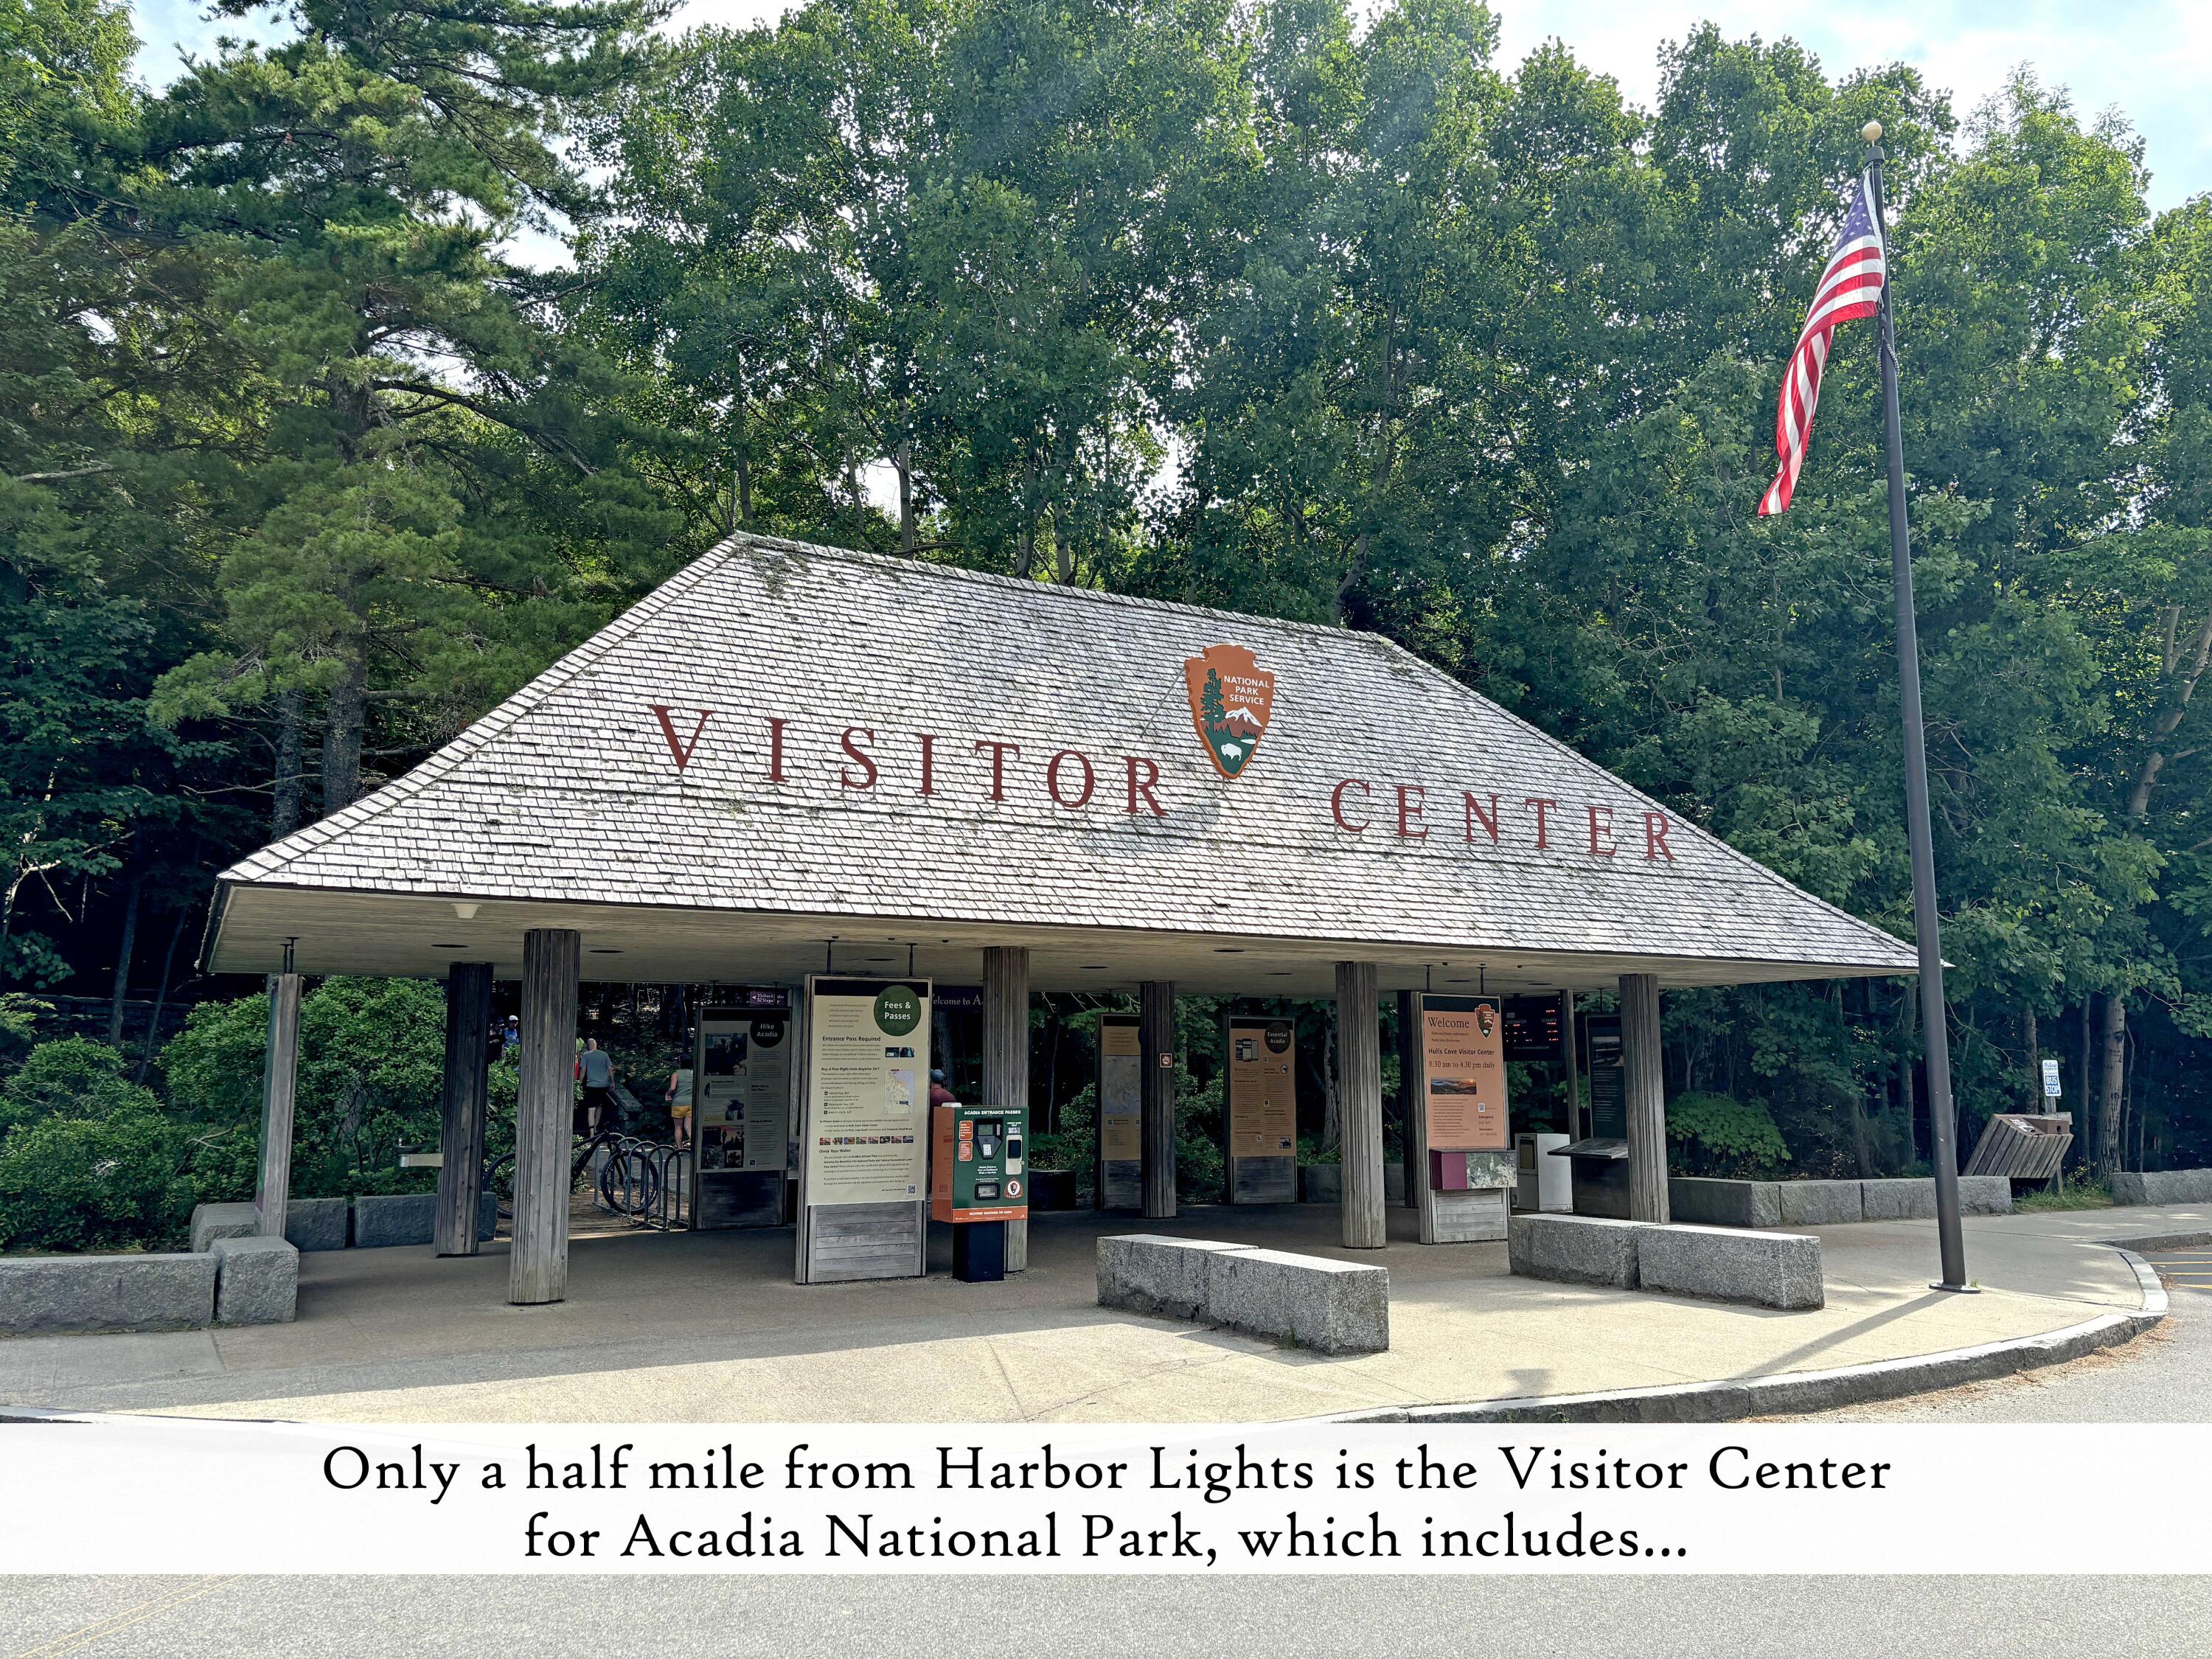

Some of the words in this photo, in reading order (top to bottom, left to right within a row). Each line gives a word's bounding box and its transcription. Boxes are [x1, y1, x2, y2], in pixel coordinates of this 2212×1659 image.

[1224, 675, 1270, 689] NATIONAL
[1235, 686, 1259, 695] PARK
[1229, 694, 1265, 706] SERVICE
[647, 704, 1169, 816] VISITOR
[1331, 779, 1677, 861] CENTER
[932, 993, 961, 1005] elcome
[973, 994, 984, 1005] A
[885, 1001, 902, 1009] Fees
[885, 1012, 911, 1020] Passes
[1427, 1017, 1470, 1028] Welcome
[1482, 1062, 1495, 1070] daily
[2046, 1076, 2057, 1085] BUS
[2046, 1085, 2059, 1093] STOP
